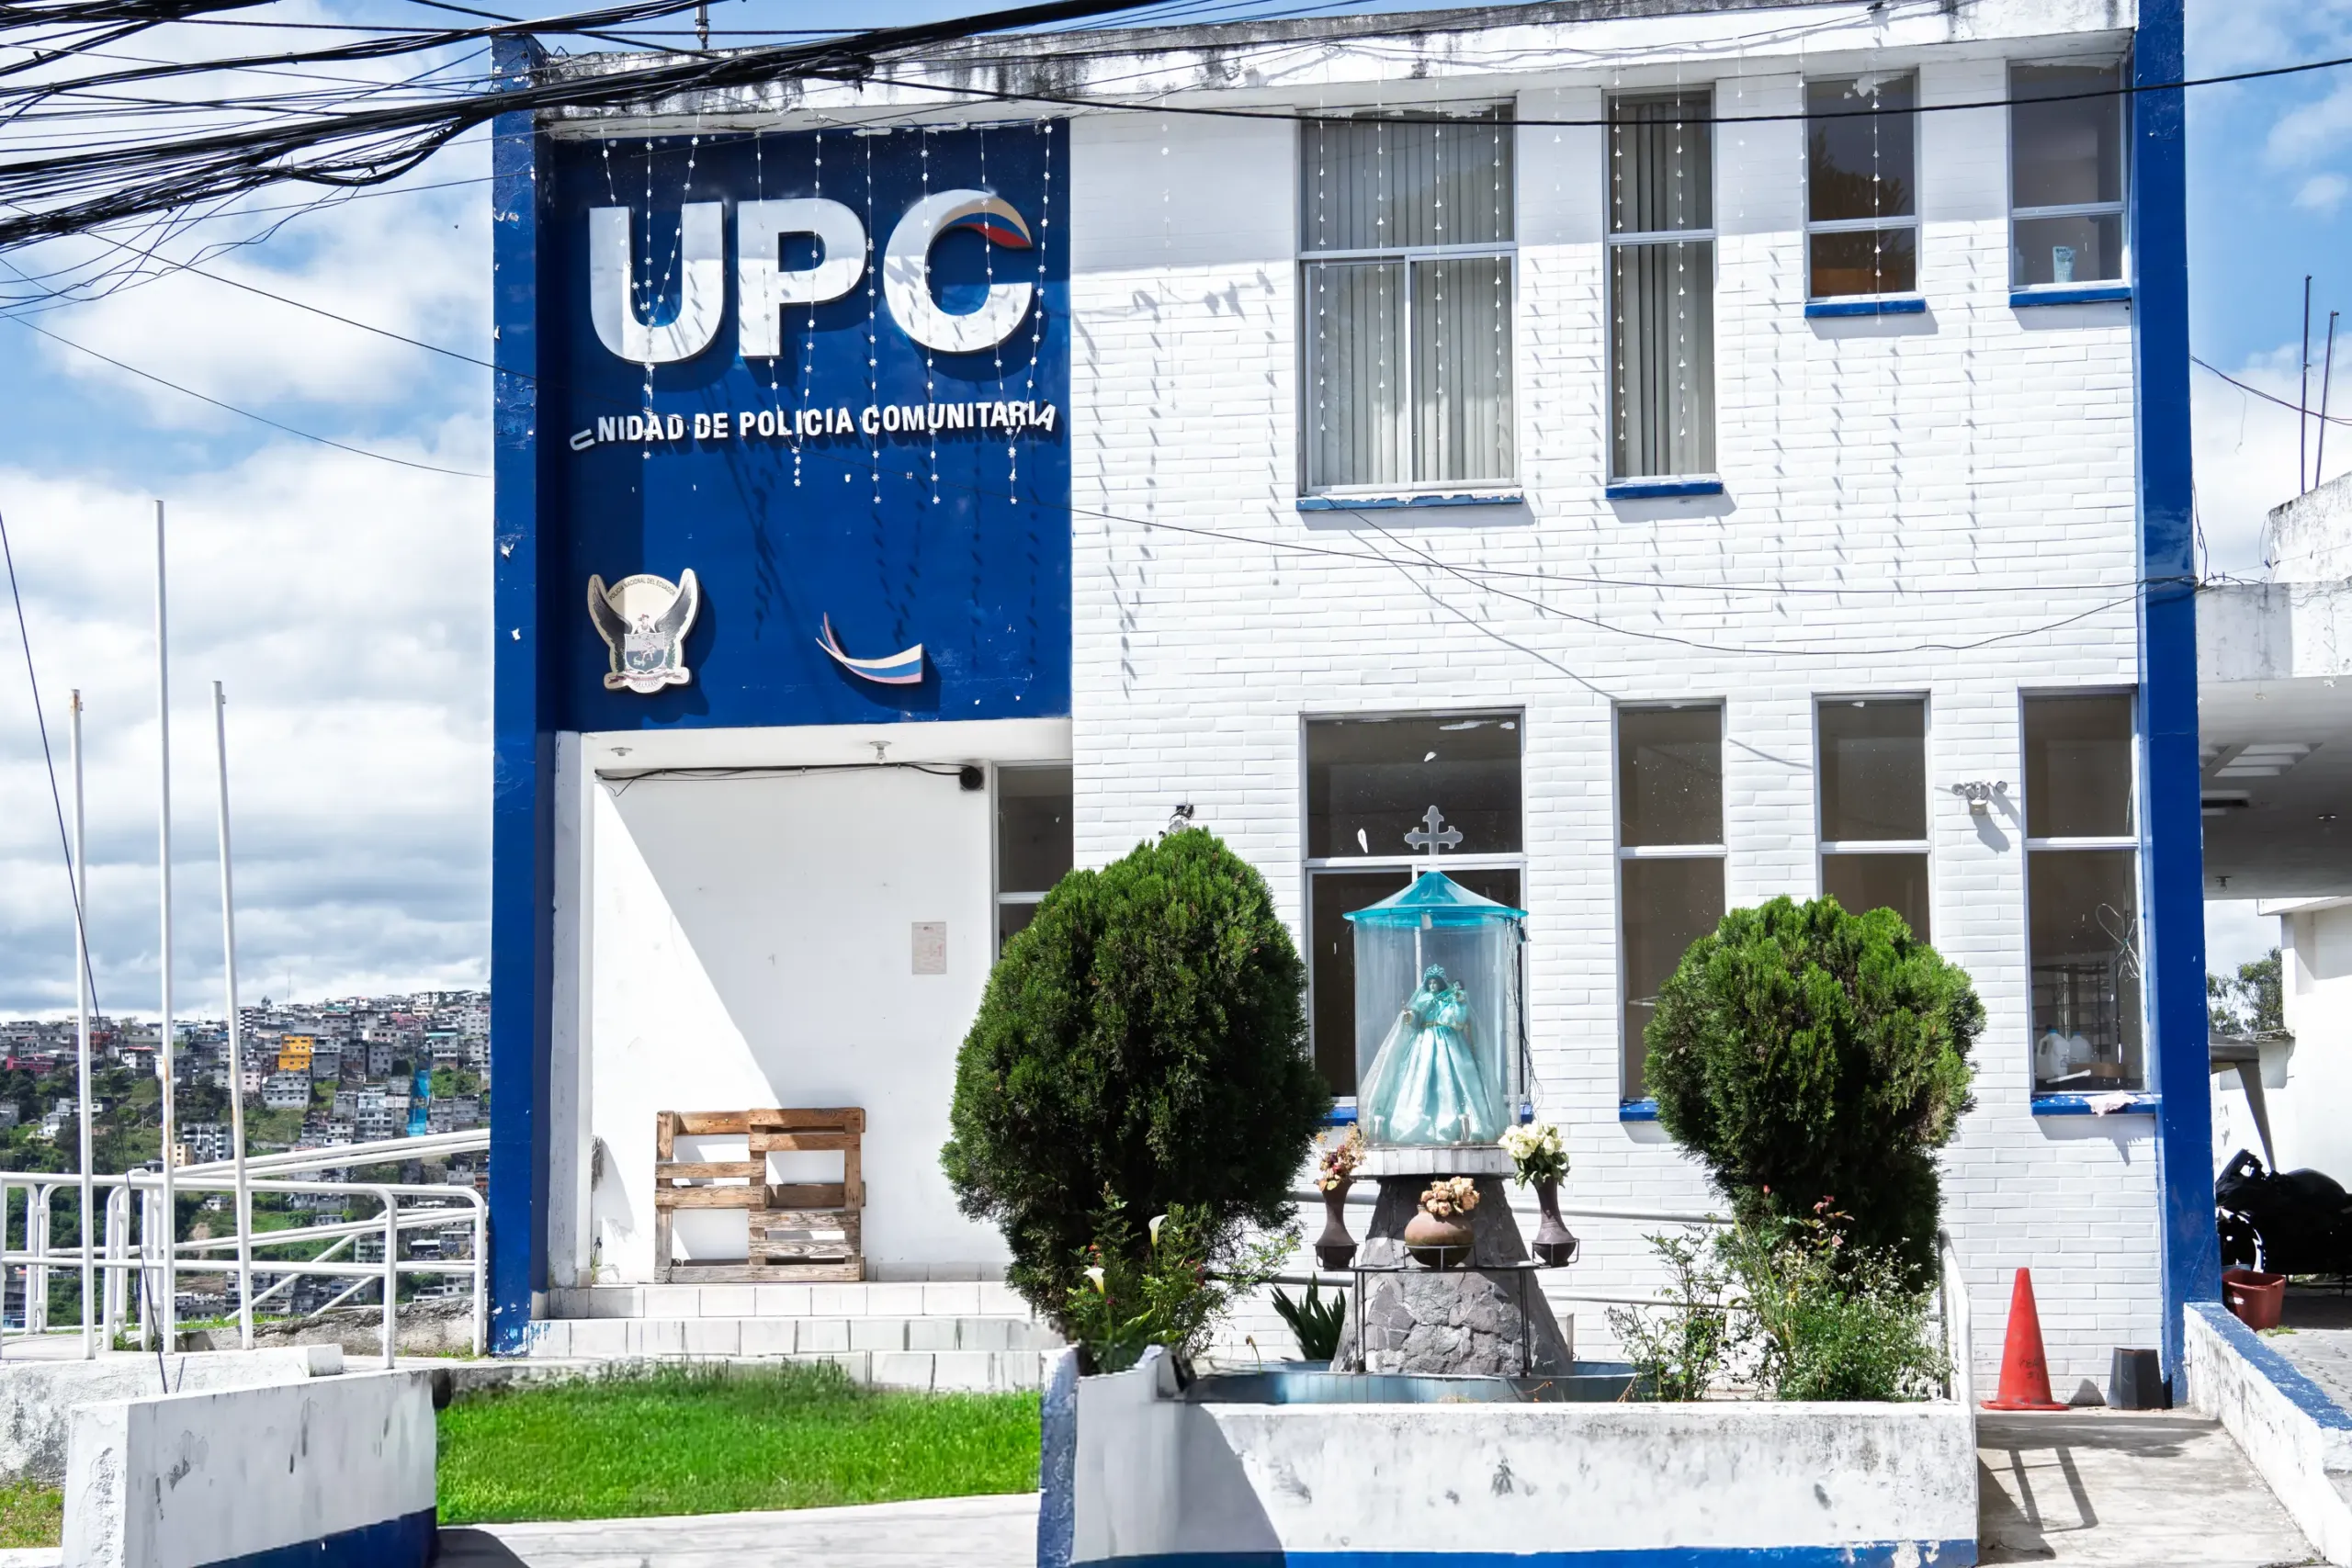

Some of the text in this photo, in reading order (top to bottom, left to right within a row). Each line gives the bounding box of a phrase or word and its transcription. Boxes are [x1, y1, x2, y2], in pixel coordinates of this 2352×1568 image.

[589, 188, 1033, 365] UPC
[569, 400, 1056, 451] UNIDAD DE POLICIA COMUNITARIA
